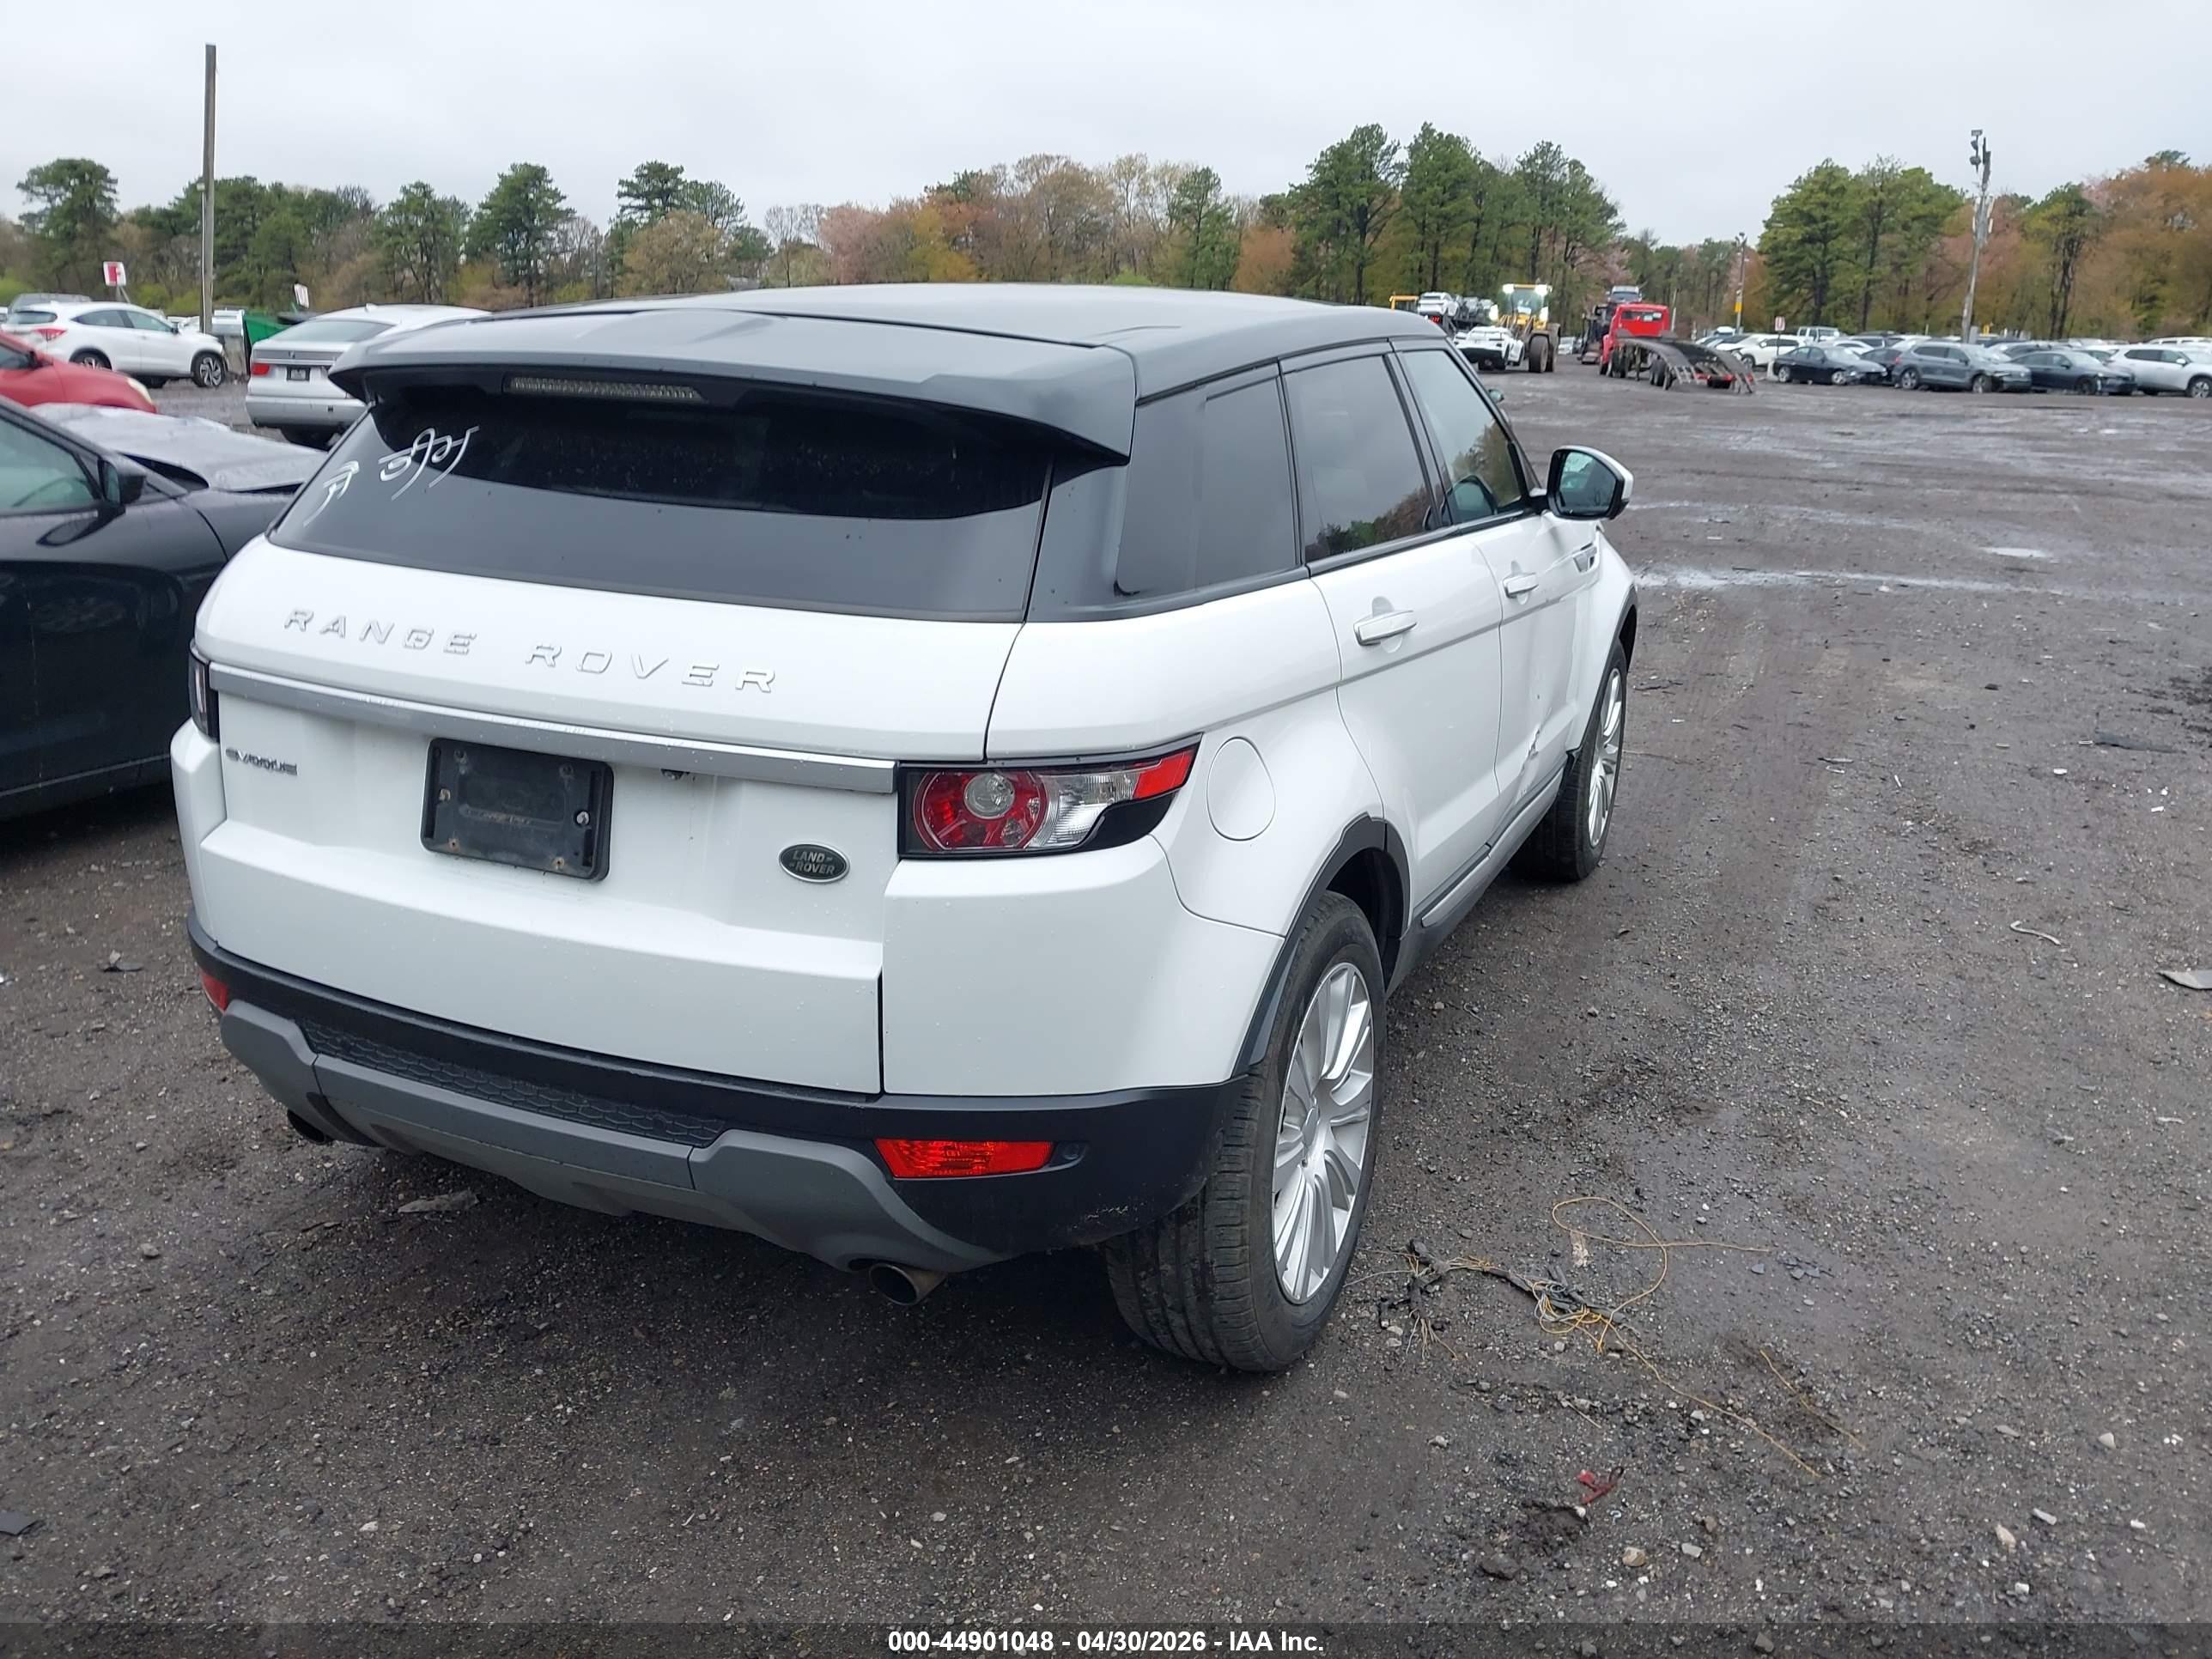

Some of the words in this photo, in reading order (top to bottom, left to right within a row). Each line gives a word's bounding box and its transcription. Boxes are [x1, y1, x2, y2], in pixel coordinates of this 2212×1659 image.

[283, 607, 477, 656] RANGE
[524, 641, 776, 694] ROVER
[792, 850, 826, 864] LAND
[794, 860, 836, 875] ROVER
